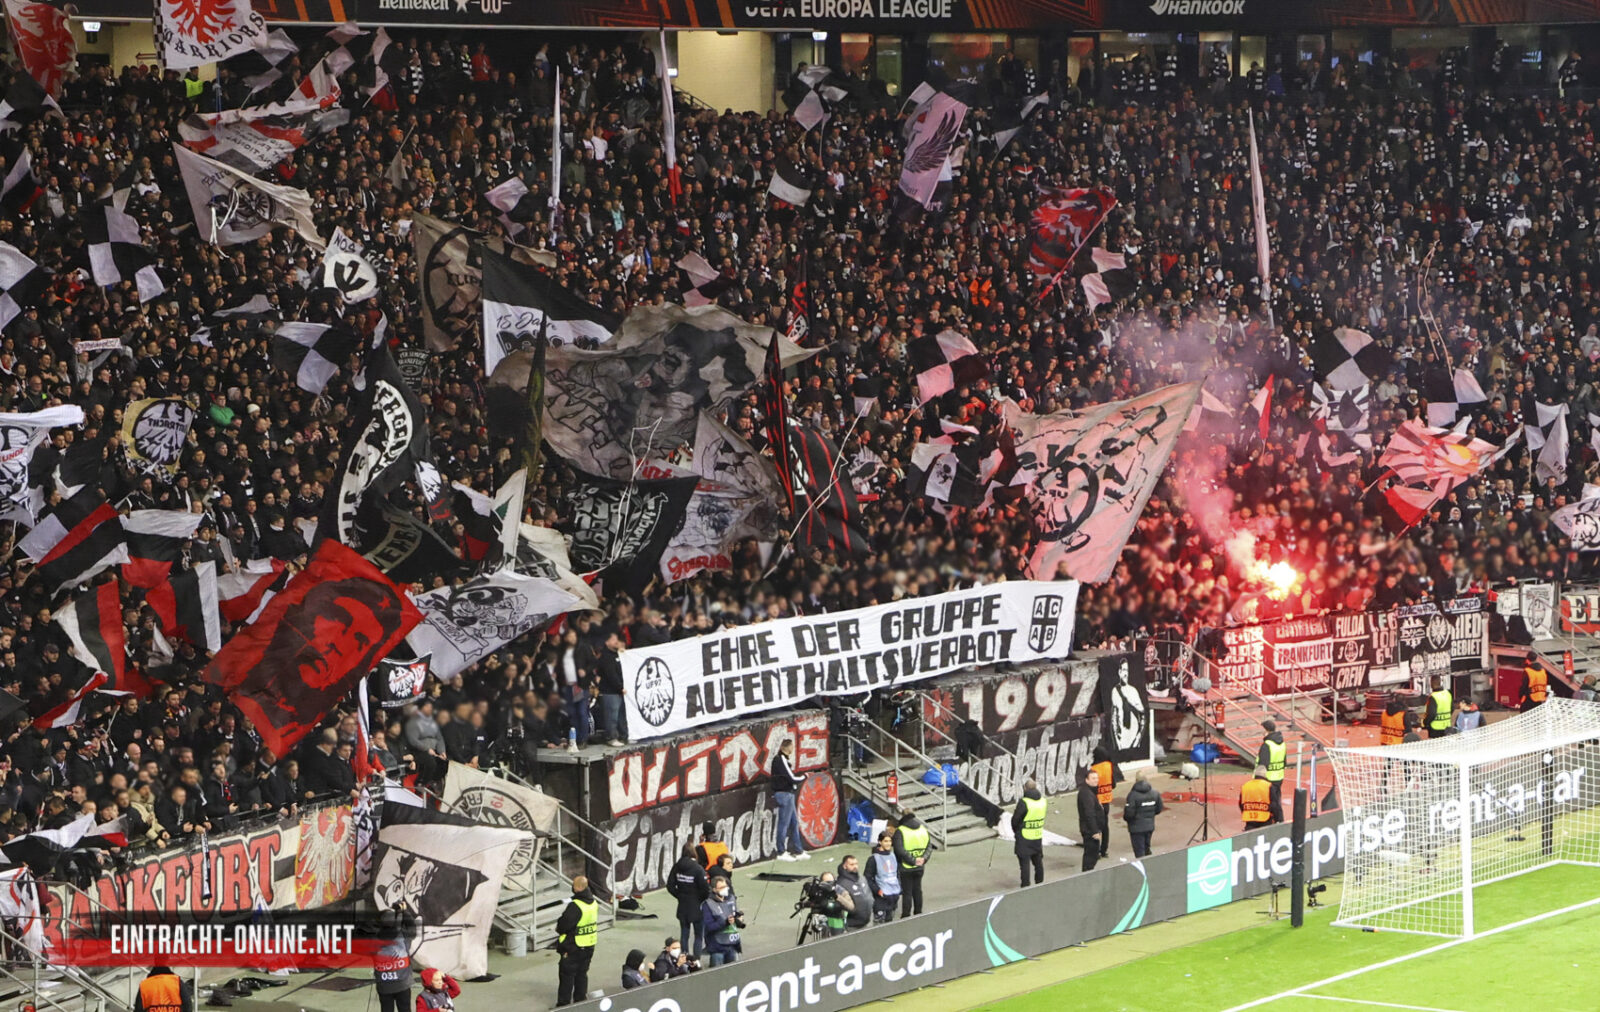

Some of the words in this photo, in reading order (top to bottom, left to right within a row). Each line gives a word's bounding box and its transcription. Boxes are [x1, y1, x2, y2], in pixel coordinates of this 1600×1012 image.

[801, 0, 875, 18] EUROPA
[880, 0, 951, 18] LEAGUE
[1168, 0, 1244, 15] Hankook
[163, 12, 264, 60] WARRIORS
[702, 630, 779, 676] EHRE
[792, 618, 861, 658] DER
[881, 594, 1002, 645] GRUPPE
[1336, 614, 1365, 637] FULDA
[1278, 642, 1332, 665] FRANKFURT
[1451, 639, 1482, 657] GEBIET
[645, 678, 662, 690] UF97
[686, 629, 1017, 719] AUFENTHALTSVERBOT
[1336, 665, 1366, 689] CREW
[962, 660, 1099, 732] 1997
[609, 715, 829, 818] ULTRAS
[606, 790, 788, 895] Eintrach
[719, 929, 953, 1012] rent-a-car
